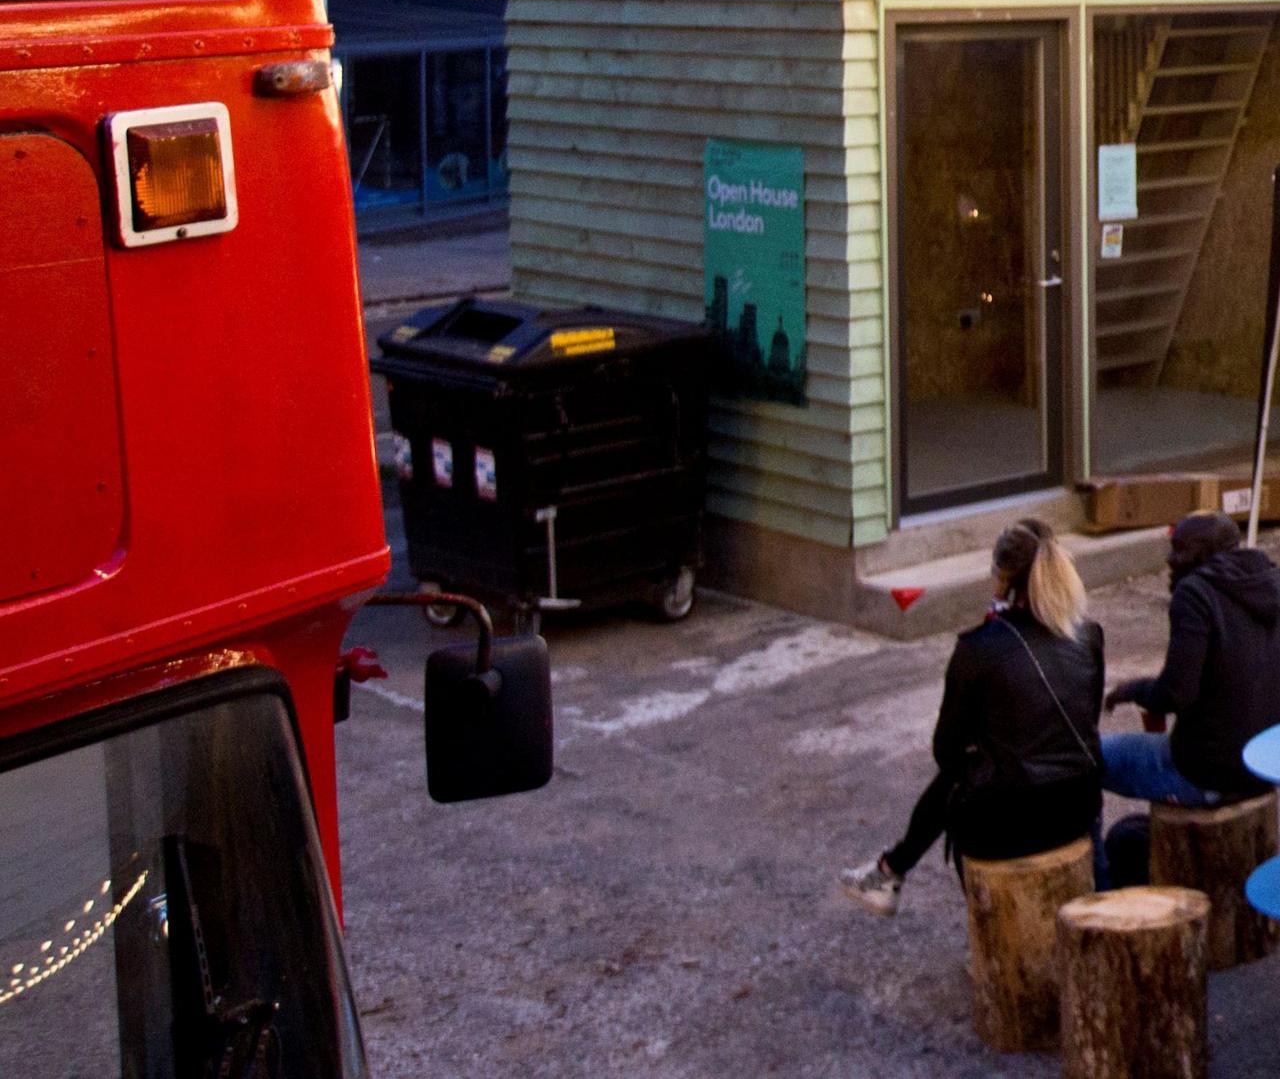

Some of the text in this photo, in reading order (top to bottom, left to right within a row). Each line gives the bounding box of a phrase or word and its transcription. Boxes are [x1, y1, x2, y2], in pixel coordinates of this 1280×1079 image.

[708, 175, 798, 209] Open House
[710, 202, 764, 234] London
